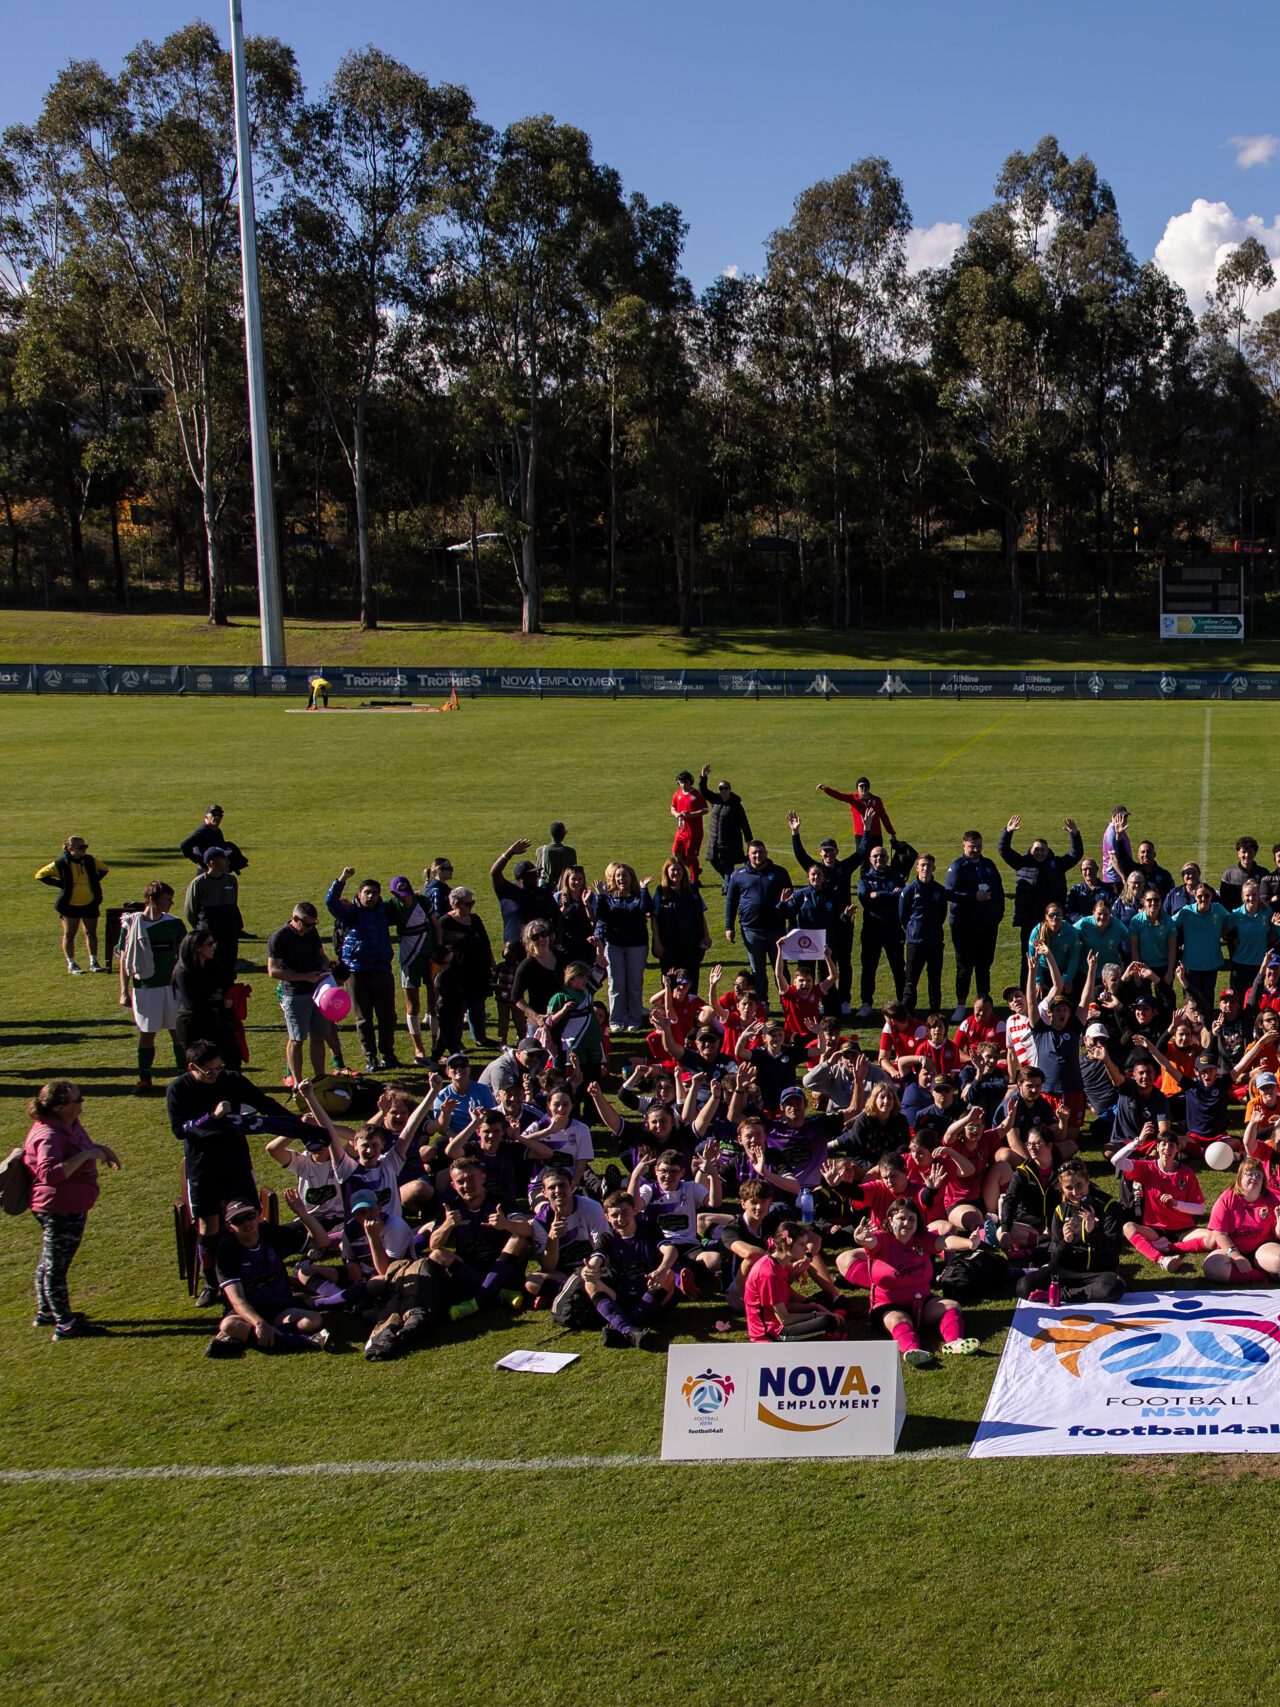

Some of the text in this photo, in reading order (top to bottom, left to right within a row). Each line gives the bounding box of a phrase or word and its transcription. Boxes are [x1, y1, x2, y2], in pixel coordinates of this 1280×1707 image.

[343, 674, 408, 686] TROPHIES
[417, 674, 482, 686] TROPHIES
[501, 676, 624, 686] NOVA EMPLOYMENT
[954, 684, 992, 693] Manager
[1027, 685, 1065, 693] Manager
[759, 1366, 881, 1397] NOVA.
[777, 1399, 880, 1411] EMPLOYMENT
[1106, 1396, 1259, 1406] FOOTBALL
[1141, 1407, 1222, 1417] NSW
